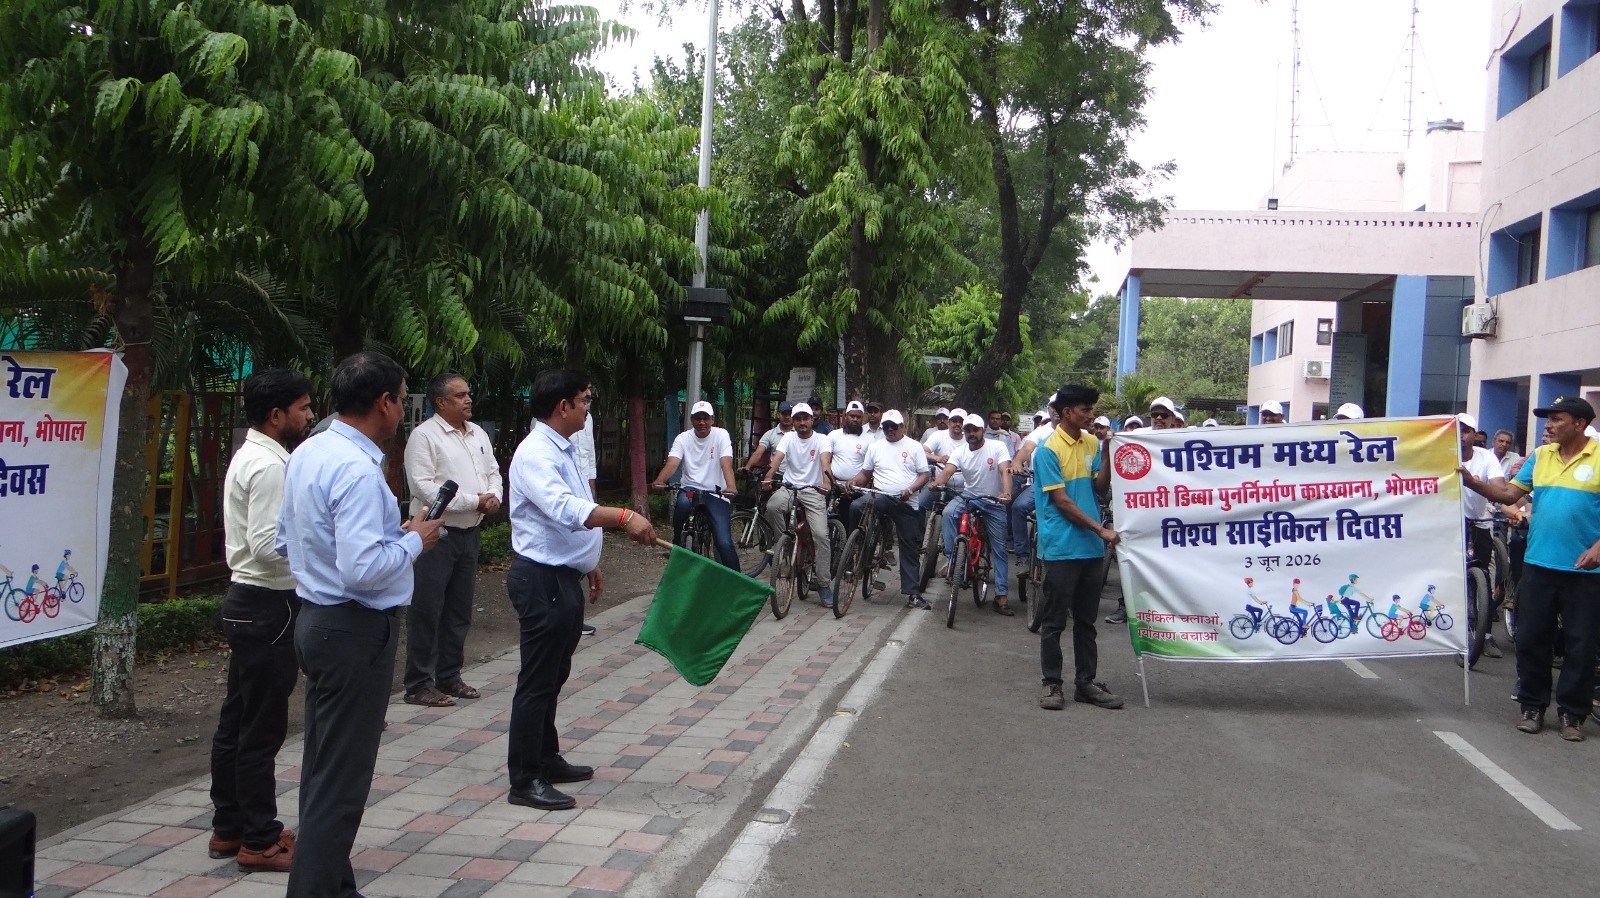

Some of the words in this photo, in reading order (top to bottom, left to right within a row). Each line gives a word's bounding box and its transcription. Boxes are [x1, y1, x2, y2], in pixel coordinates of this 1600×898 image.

[1, 355, 57, 399] रेल
[35, 413, 87, 441] भोपाल
[1161, 439, 1264, 472] पश्चिम
[1272, 440, 1338, 467] मध्य
[1339, 430, 1397, 463] रेल
[1124, 485, 1170, 509] सवारी
[1174, 484, 1213, 507] डिब्बा
[1218, 479, 1297, 512] पुनर्निर्माण
[1299, 480, 1379, 501] कारखाना,
[1384, 473, 1439, 496] भोपाल
[1161, 517, 1220, 549] विश्व
[1225, 511, 1330, 548] साईकिल
[1336, 508, 1404, 541] दिवस
[1244, 556, 1253, 569] 3
[1258, 555, 1281, 572] जून
[1285, 553, 1321, 567] 2026
[1179, 629, 1219, 641] बचाओ
